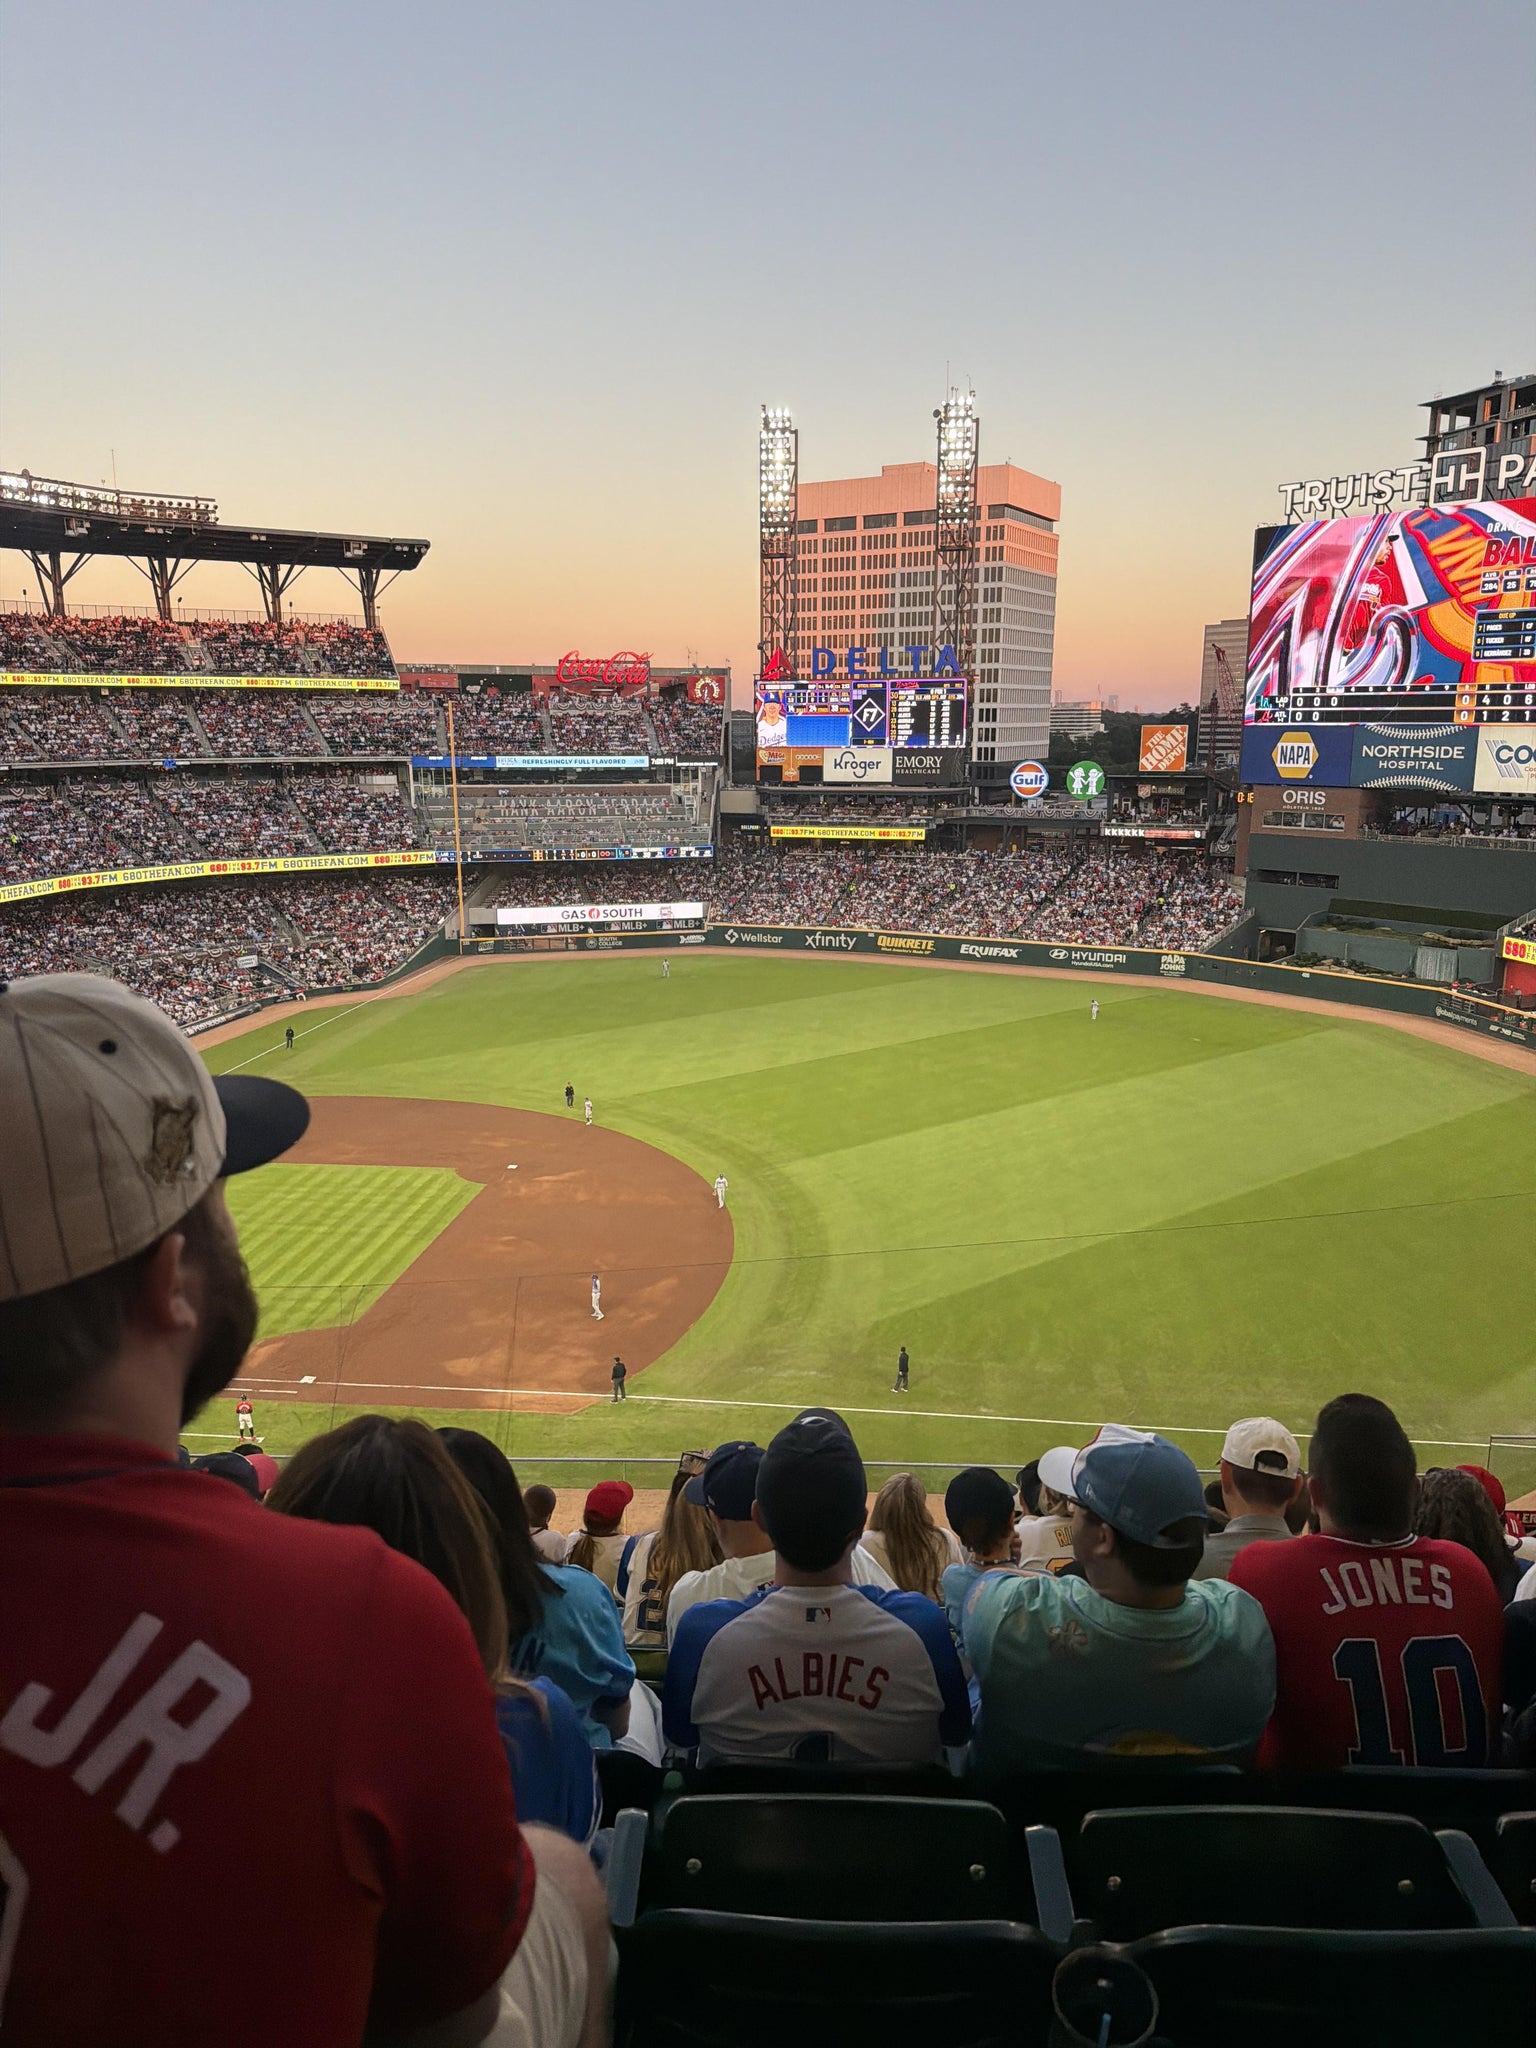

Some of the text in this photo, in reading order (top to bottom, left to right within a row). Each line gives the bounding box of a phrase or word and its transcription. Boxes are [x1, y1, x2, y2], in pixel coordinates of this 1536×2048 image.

[1278, 466, 1423, 515] TRUIST
[812, 645, 960, 675] DELTA
[1296, 697, 1303, 707] 0
[1313, 697, 1320, 707] 0
[1331, 697, 1338, 706] 0
[1462, 695, 1469, 705] 0
[1482, 695, 1490, 705] 4
[1503, 694, 1511, 705] 0
[1525, 694, 1533, 704] 6
[862, 708, 878, 722] F7
[1296, 712, 1302, 721] 0
[1312, 712, 1319, 721] 0
[1460, 711, 1468, 721] 0
[1483, 711, 1487, 721] 1
[1501, 711, 1510, 720] 2
[1525, 711, 1530, 720] 1
[1145, 730, 1165, 749] THE
[1140, 726, 1186, 770] HOME
[1279, 745, 1310, 764] NAPA
[1362, 745, 1465, 759] NORTHSIDE
[1495, 744, 1536, 764] CO
[895, 756, 943, 768] EMORY
[1157, 742, 1186, 770] DEPOT
[834, 751, 882, 778] Kroger
[1379, 761, 1444, 770] HOSPITAL
[1013, 774, 1045, 786] Gulf
[1282, 790, 1326, 805] ORIS
[0, 881, 54, 899] THEFAN.COM
[59, 878, 71, 889] 680
[123, 865, 204, 881] 680THEFAN.COM
[210, 864, 227, 872] 680
[283, 857, 368, 868] 680THEFAN.COM
[375, 855, 390, 864] 680
[561, 908, 642, 919] GAS SOUTH
[558, 924, 585, 932] MLB+
[621, 922, 648, 931] MLB+
[673, 920, 700, 928] MLB+
[741, 932, 783, 943] Wellstar
[805, 931, 856, 949] xfinity
[877, 935, 934, 950] QUIKRETE
[960, 944, 1019, 958] EQUIFAX
[1505, 940, 1526, 958] 680
[1071, 951, 1126, 963] HYUNDAI
[1161, 954, 1185, 965] PAPA
[1160, 963, 1185, 971] JOHNS
[1320, 1558, 1454, 1615] JONES
[748, 1652, 890, 1710] ALBIES
[1332, 1634, 1489, 1766] 10
[0, 1611, 252, 1854] JR.
